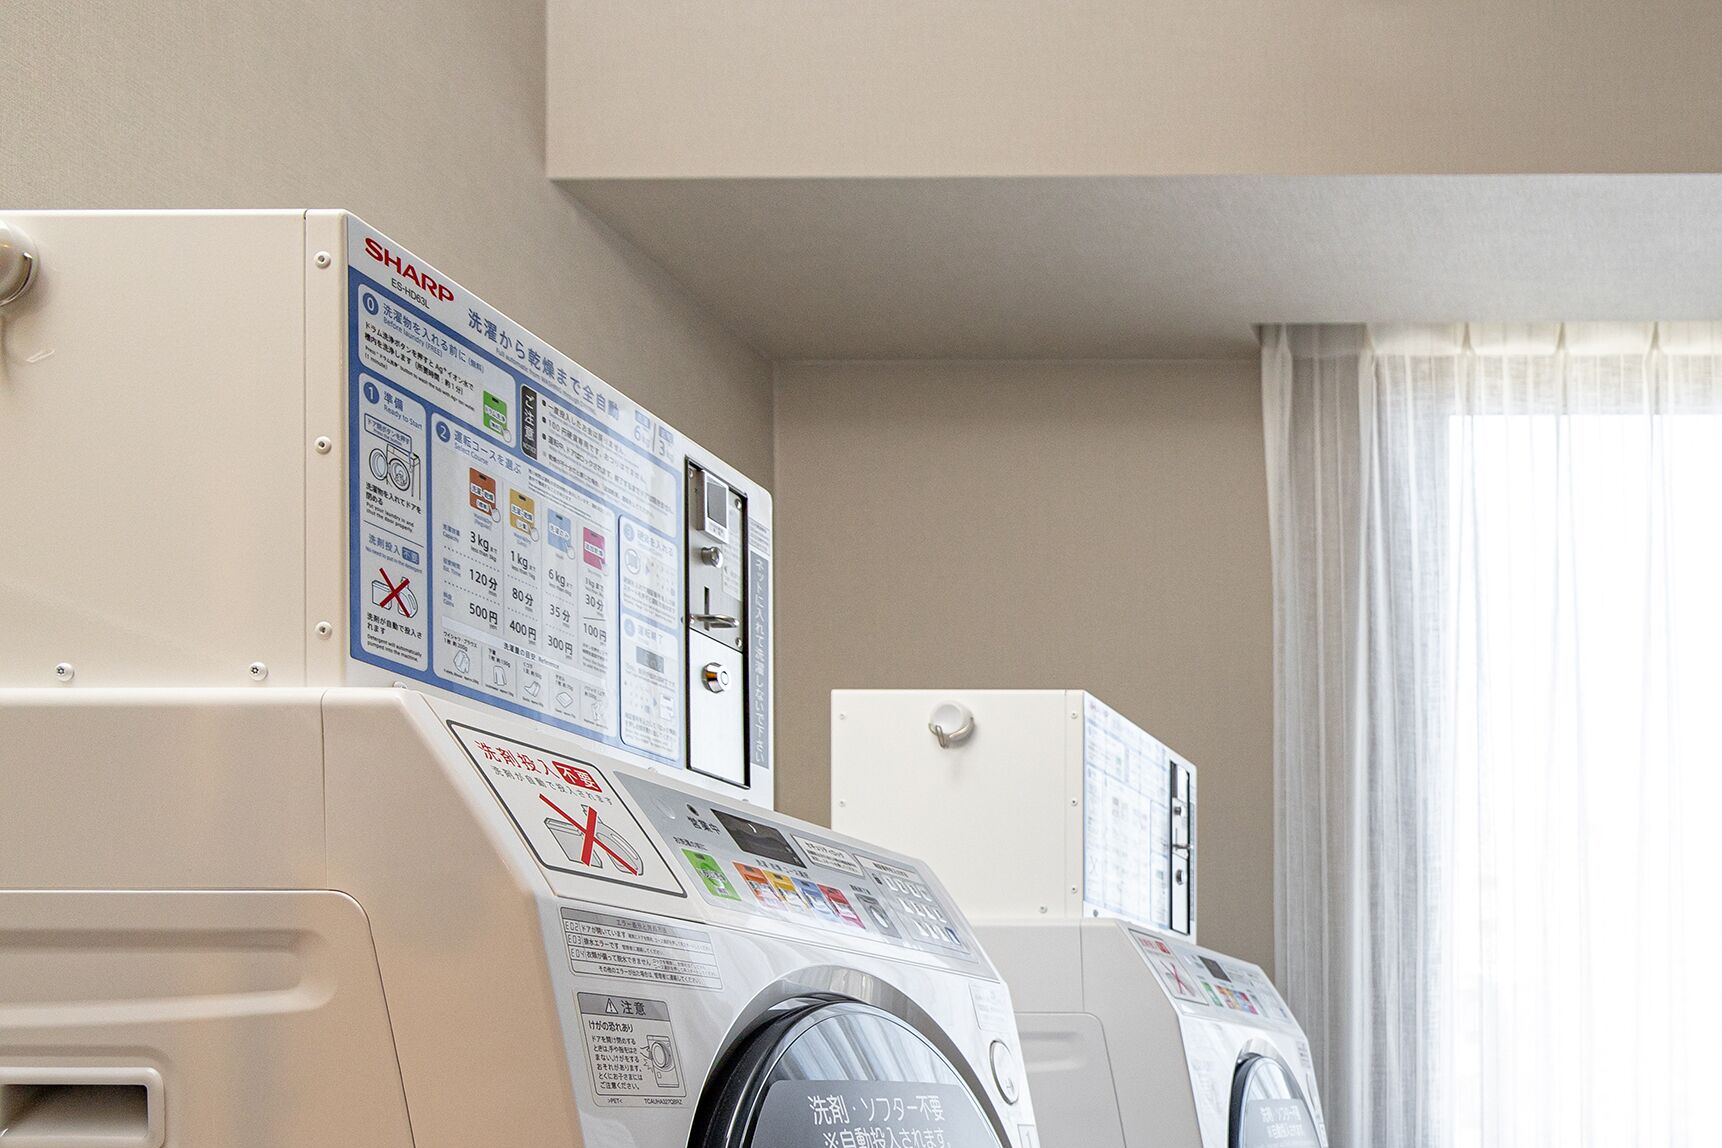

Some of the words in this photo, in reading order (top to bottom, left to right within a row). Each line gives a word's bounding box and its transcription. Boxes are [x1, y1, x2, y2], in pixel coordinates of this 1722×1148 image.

[364, 237, 455, 302] SHARP
[467, 307, 620, 421] 洗濯から乾燥まで全自動
[469, 568, 498, 592] 120分
[511, 587, 534, 607] 80分
[469, 603, 498, 625] 500円
[549, 604, 571, 623] 35分
[509, 620, 537, 641] 400円
[583, 623, 607, 643] 100円
[547, 635, 573, 656] 300円
[474, 740, 560, 779] 洗剤投入
[555, 762, 600, 791] 不要
[620, 1000, 647, 1016] 注意
[588, 1020, 634, 1033] けがの恐れあり
[807, 1094, 946, 1126] 洗剤・ソフター不要
